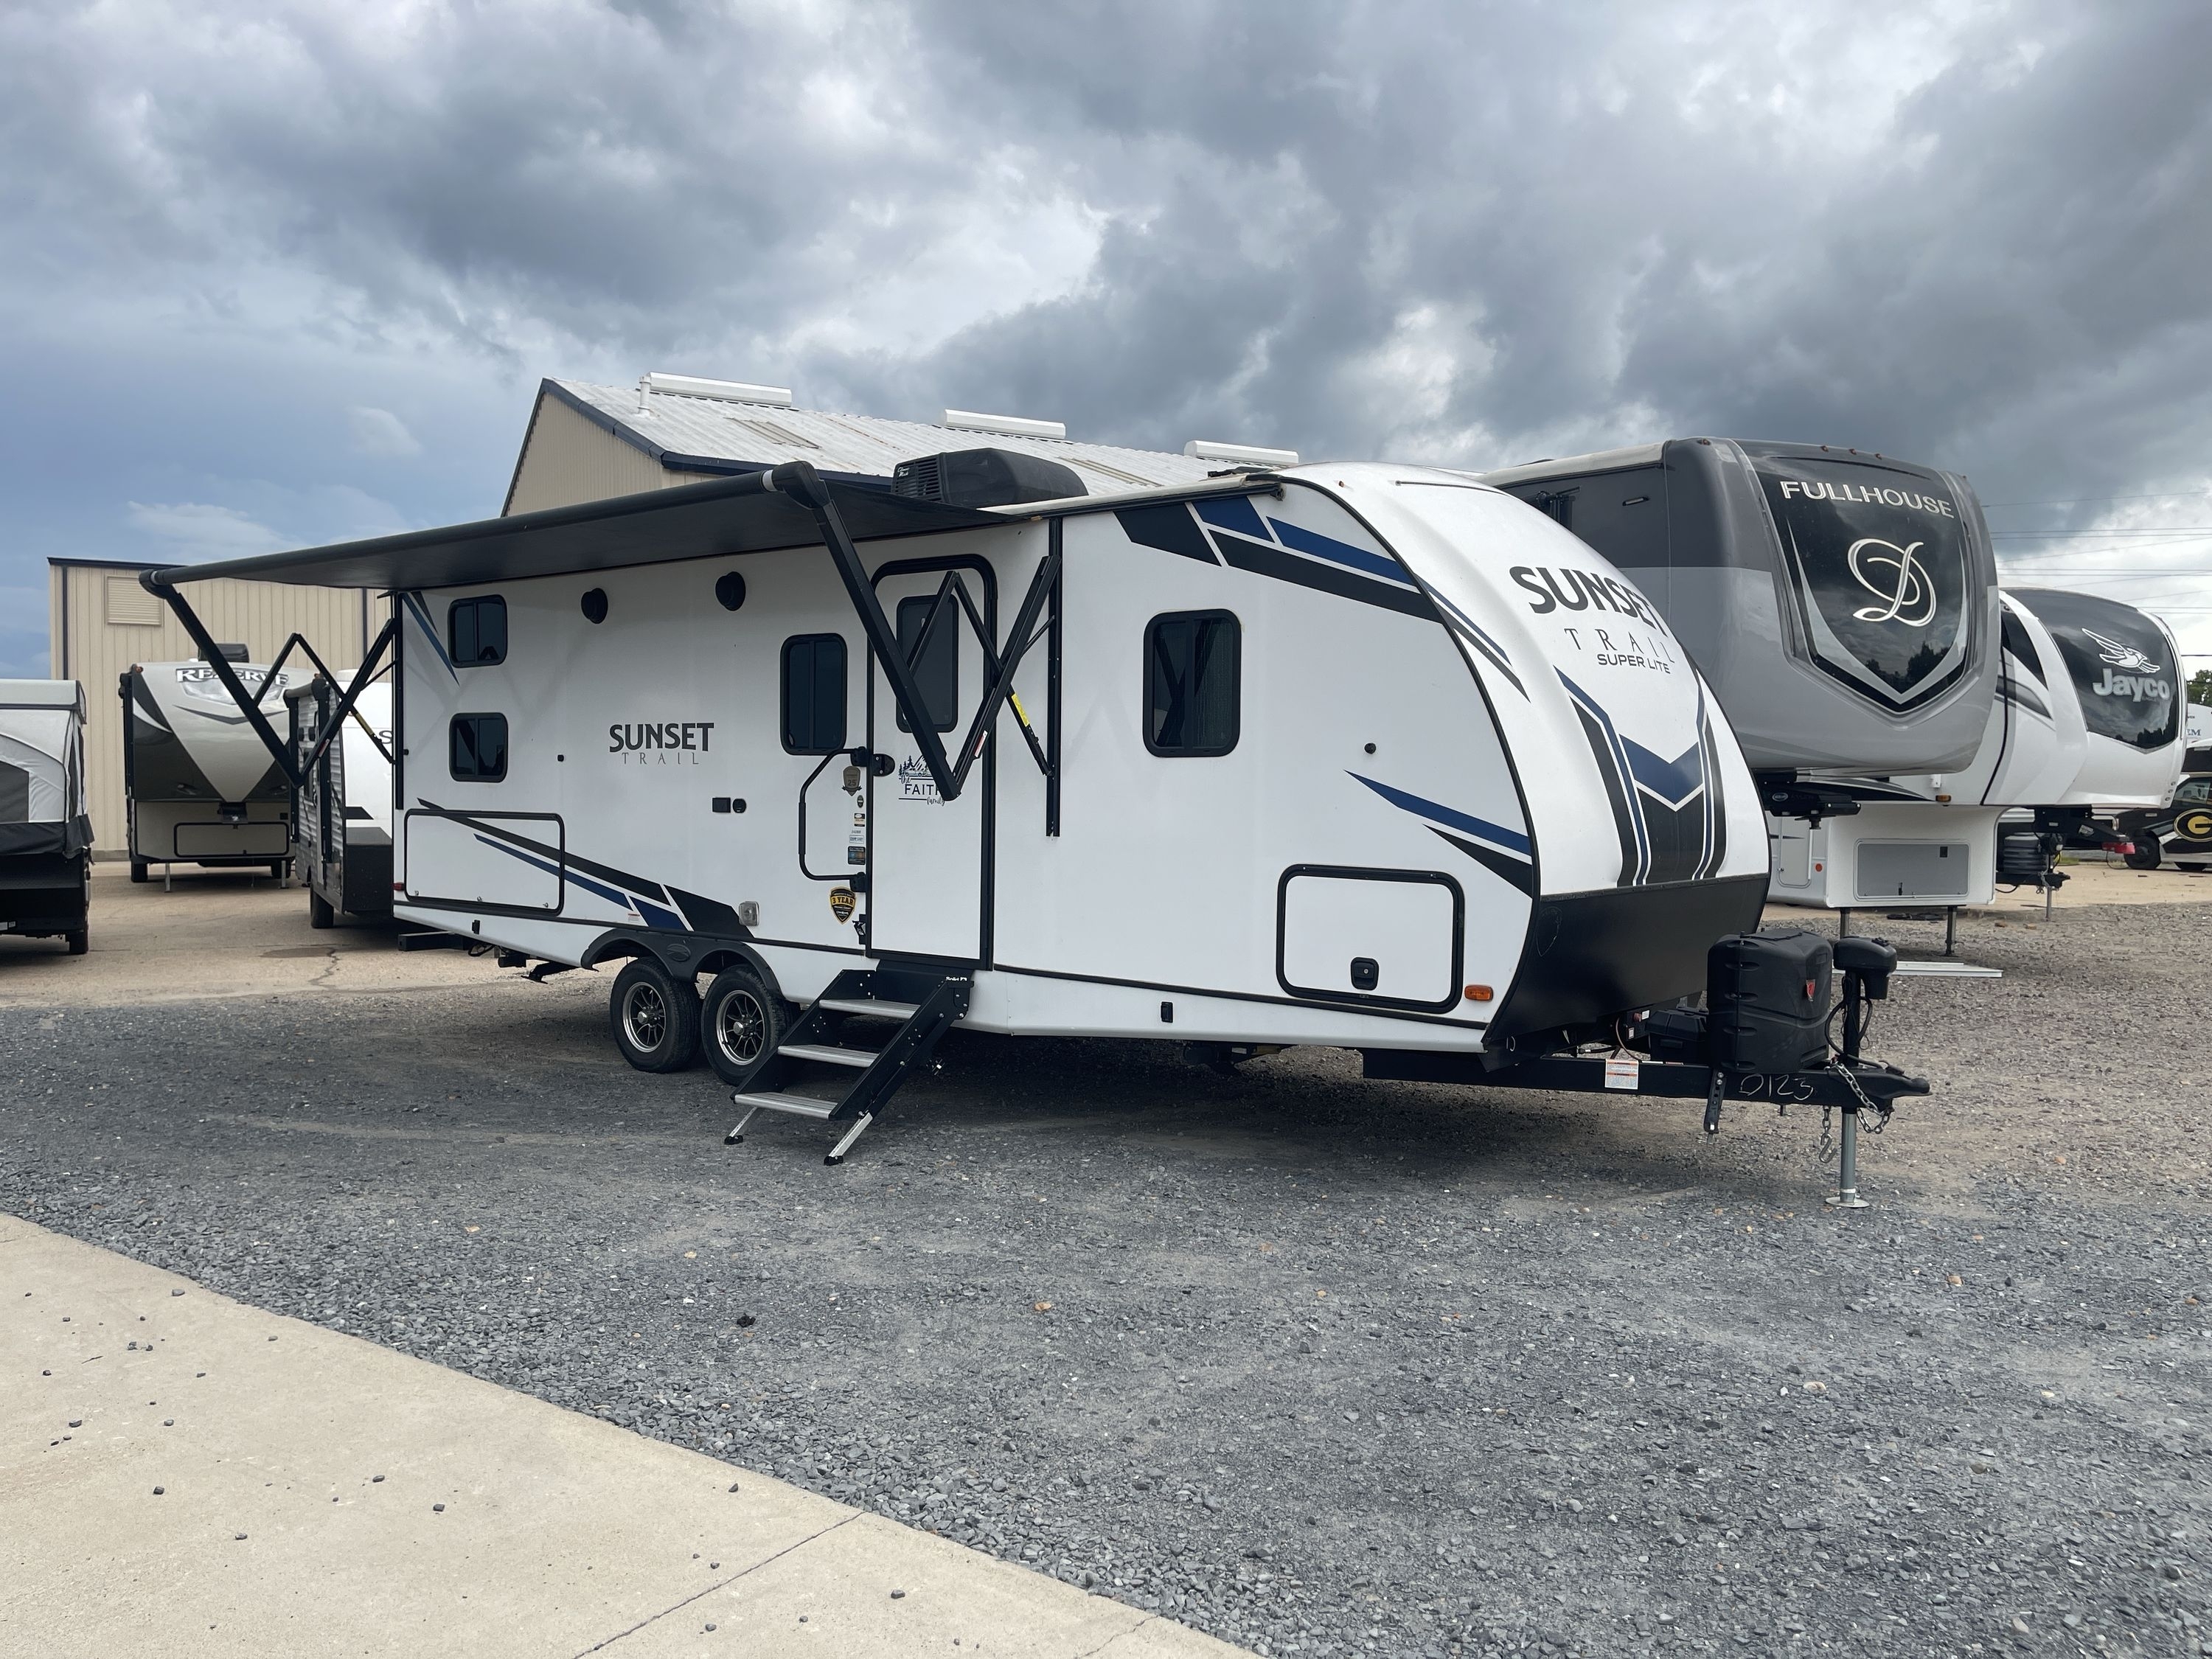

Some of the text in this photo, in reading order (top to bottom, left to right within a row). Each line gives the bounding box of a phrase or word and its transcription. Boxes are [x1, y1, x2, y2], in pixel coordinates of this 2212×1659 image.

[1780, 481, 1954, 519] FULLHOUSE
[1509, 566, 1669, 638] SUNSET
[1564, 627, 1675, 664] TRAIL
[175, 668, 290, 687] REERVE
[1596, 653, 1671, 675] SUPER LITE
[2092, 667, 2170, 703] Jayco
[609, 722, 714, 753] SUNSET
[622, 751, 700, 765] TRAIL
[832, 897, 854, 906] 3 YEAR
